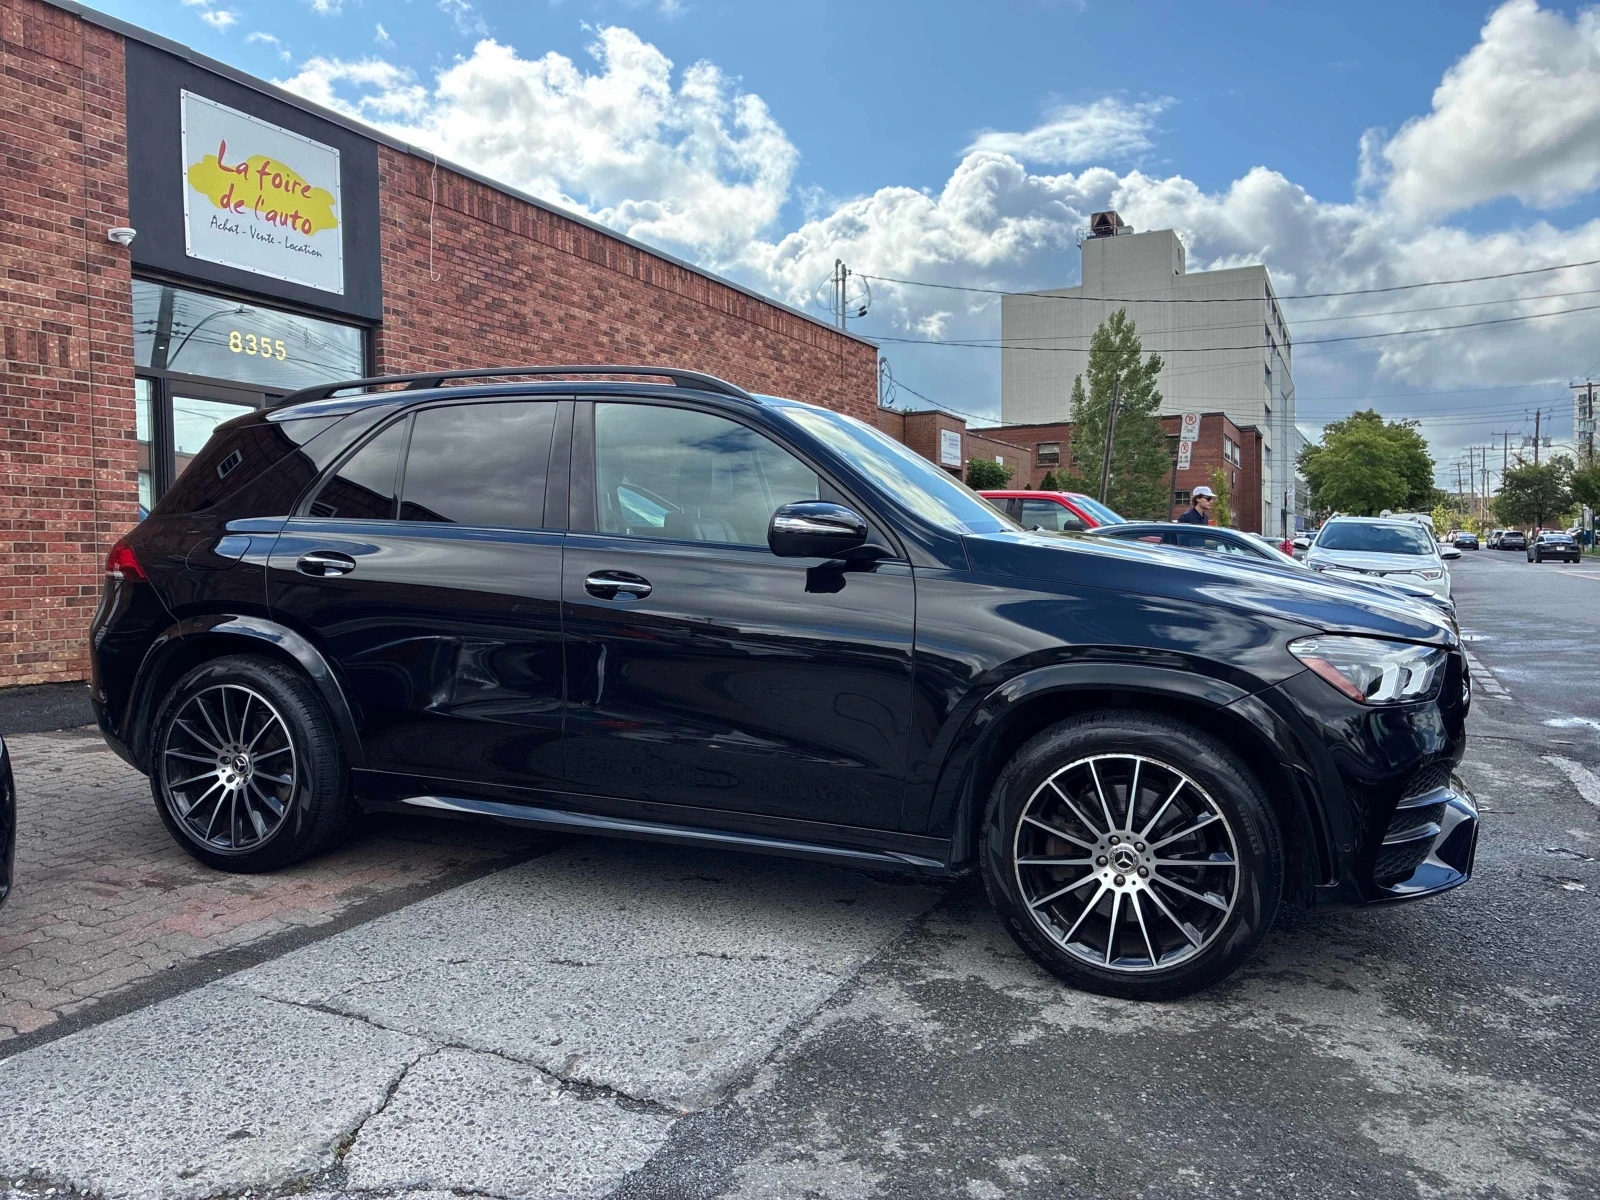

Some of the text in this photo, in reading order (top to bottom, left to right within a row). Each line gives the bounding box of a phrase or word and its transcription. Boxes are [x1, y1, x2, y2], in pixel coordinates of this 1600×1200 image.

[217, 139, 312, 199] La foire
[219, 183, 312, 235] de l'auto
[210, 214, 239, 235] Achat
[249, 225, 275, 245] Vente
[285, 236, 323, 258] Location
[229, 330, 287, 361] 8355
